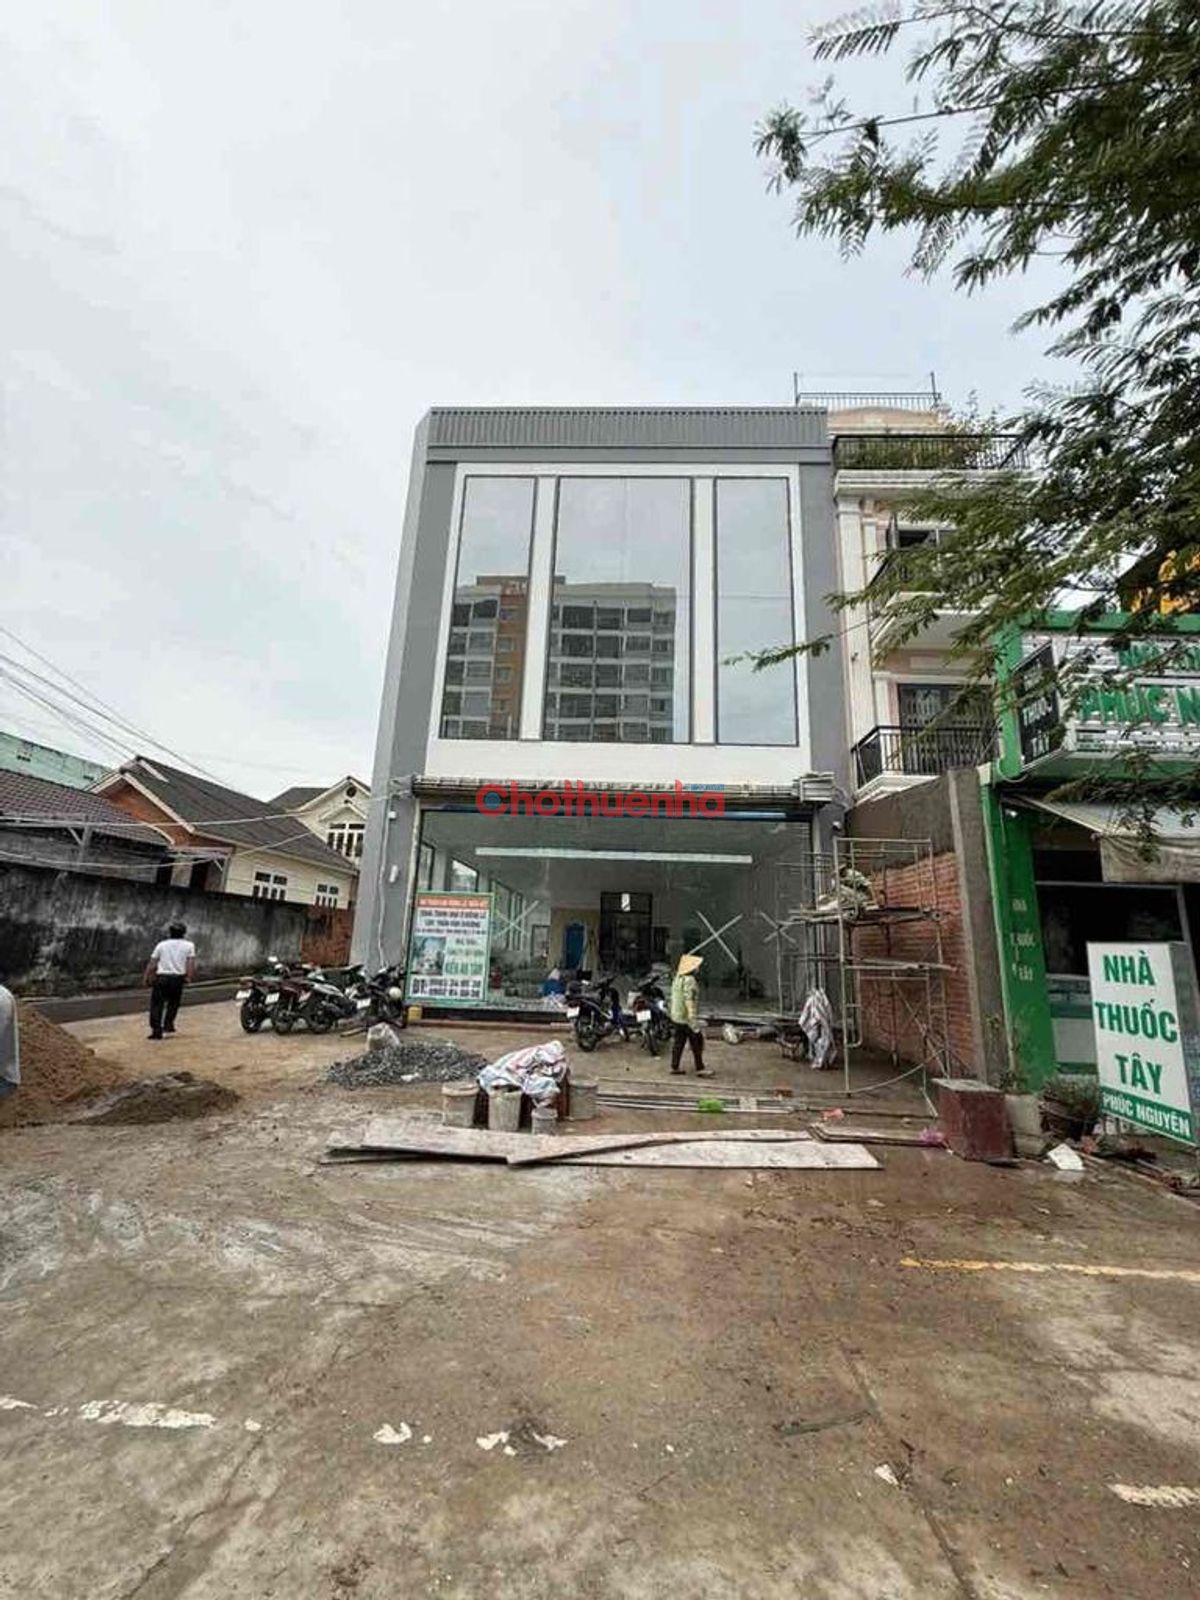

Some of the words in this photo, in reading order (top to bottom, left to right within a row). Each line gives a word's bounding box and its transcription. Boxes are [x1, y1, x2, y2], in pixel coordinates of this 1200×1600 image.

[1103, 949, 1156, 986] NHÀ
[1095, 998, 1178, 1043] THUỐC
[1115, 1052, 1163, 1095] TÂY
[1103, 1091, 1134, 1116] PHÚC
